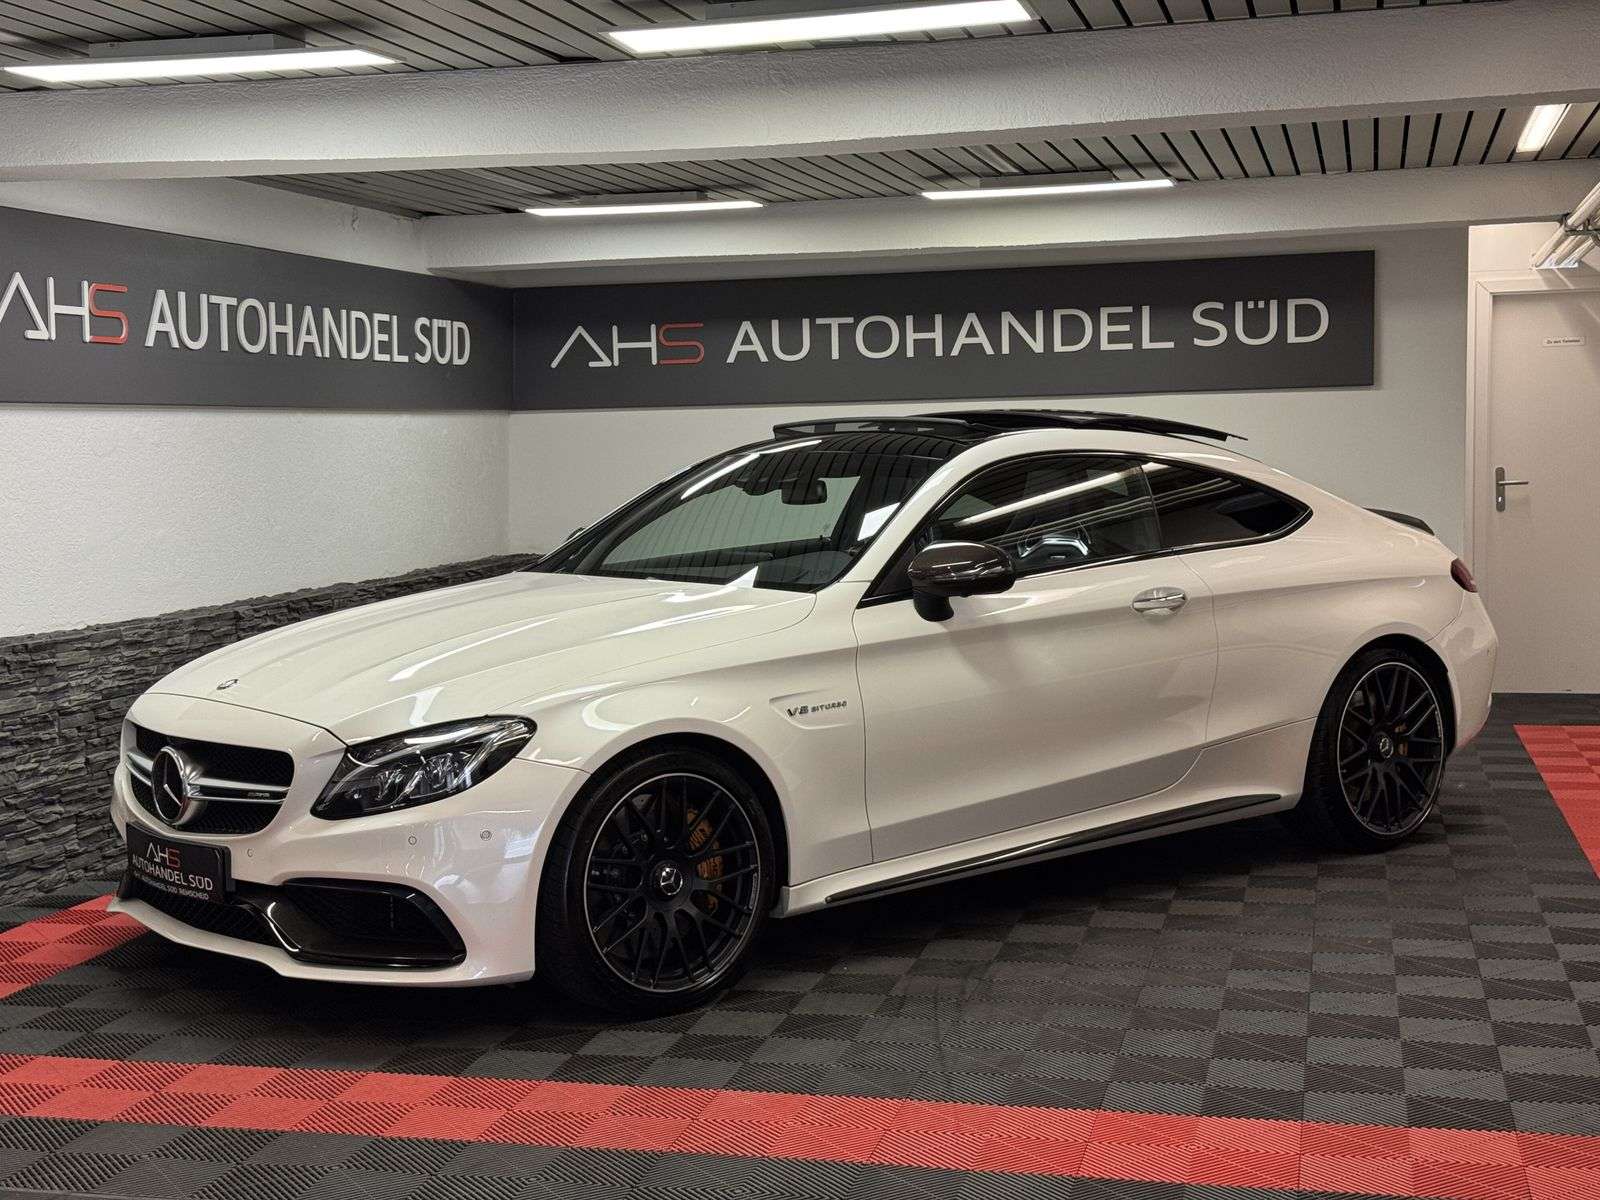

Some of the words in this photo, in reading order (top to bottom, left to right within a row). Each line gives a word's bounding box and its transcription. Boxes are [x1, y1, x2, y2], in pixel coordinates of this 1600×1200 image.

[0, 271, 128, 344] AHS
[144, 289, 409, 363] AUTOHANDEL
[414, 316, 471, 366] SÜD
[550, 322, 705, 369] AHS
[725, 305, 1175, 363] AUTOHANDEL
[1192, 297, 1330, 347] SÜD
[786, 705, 809, 717] V8
[132, 853, 187, 886] AUTOHANDEL
[188, 874, 214, 891] SÜD
[146, 842, 181, 869] AHS
